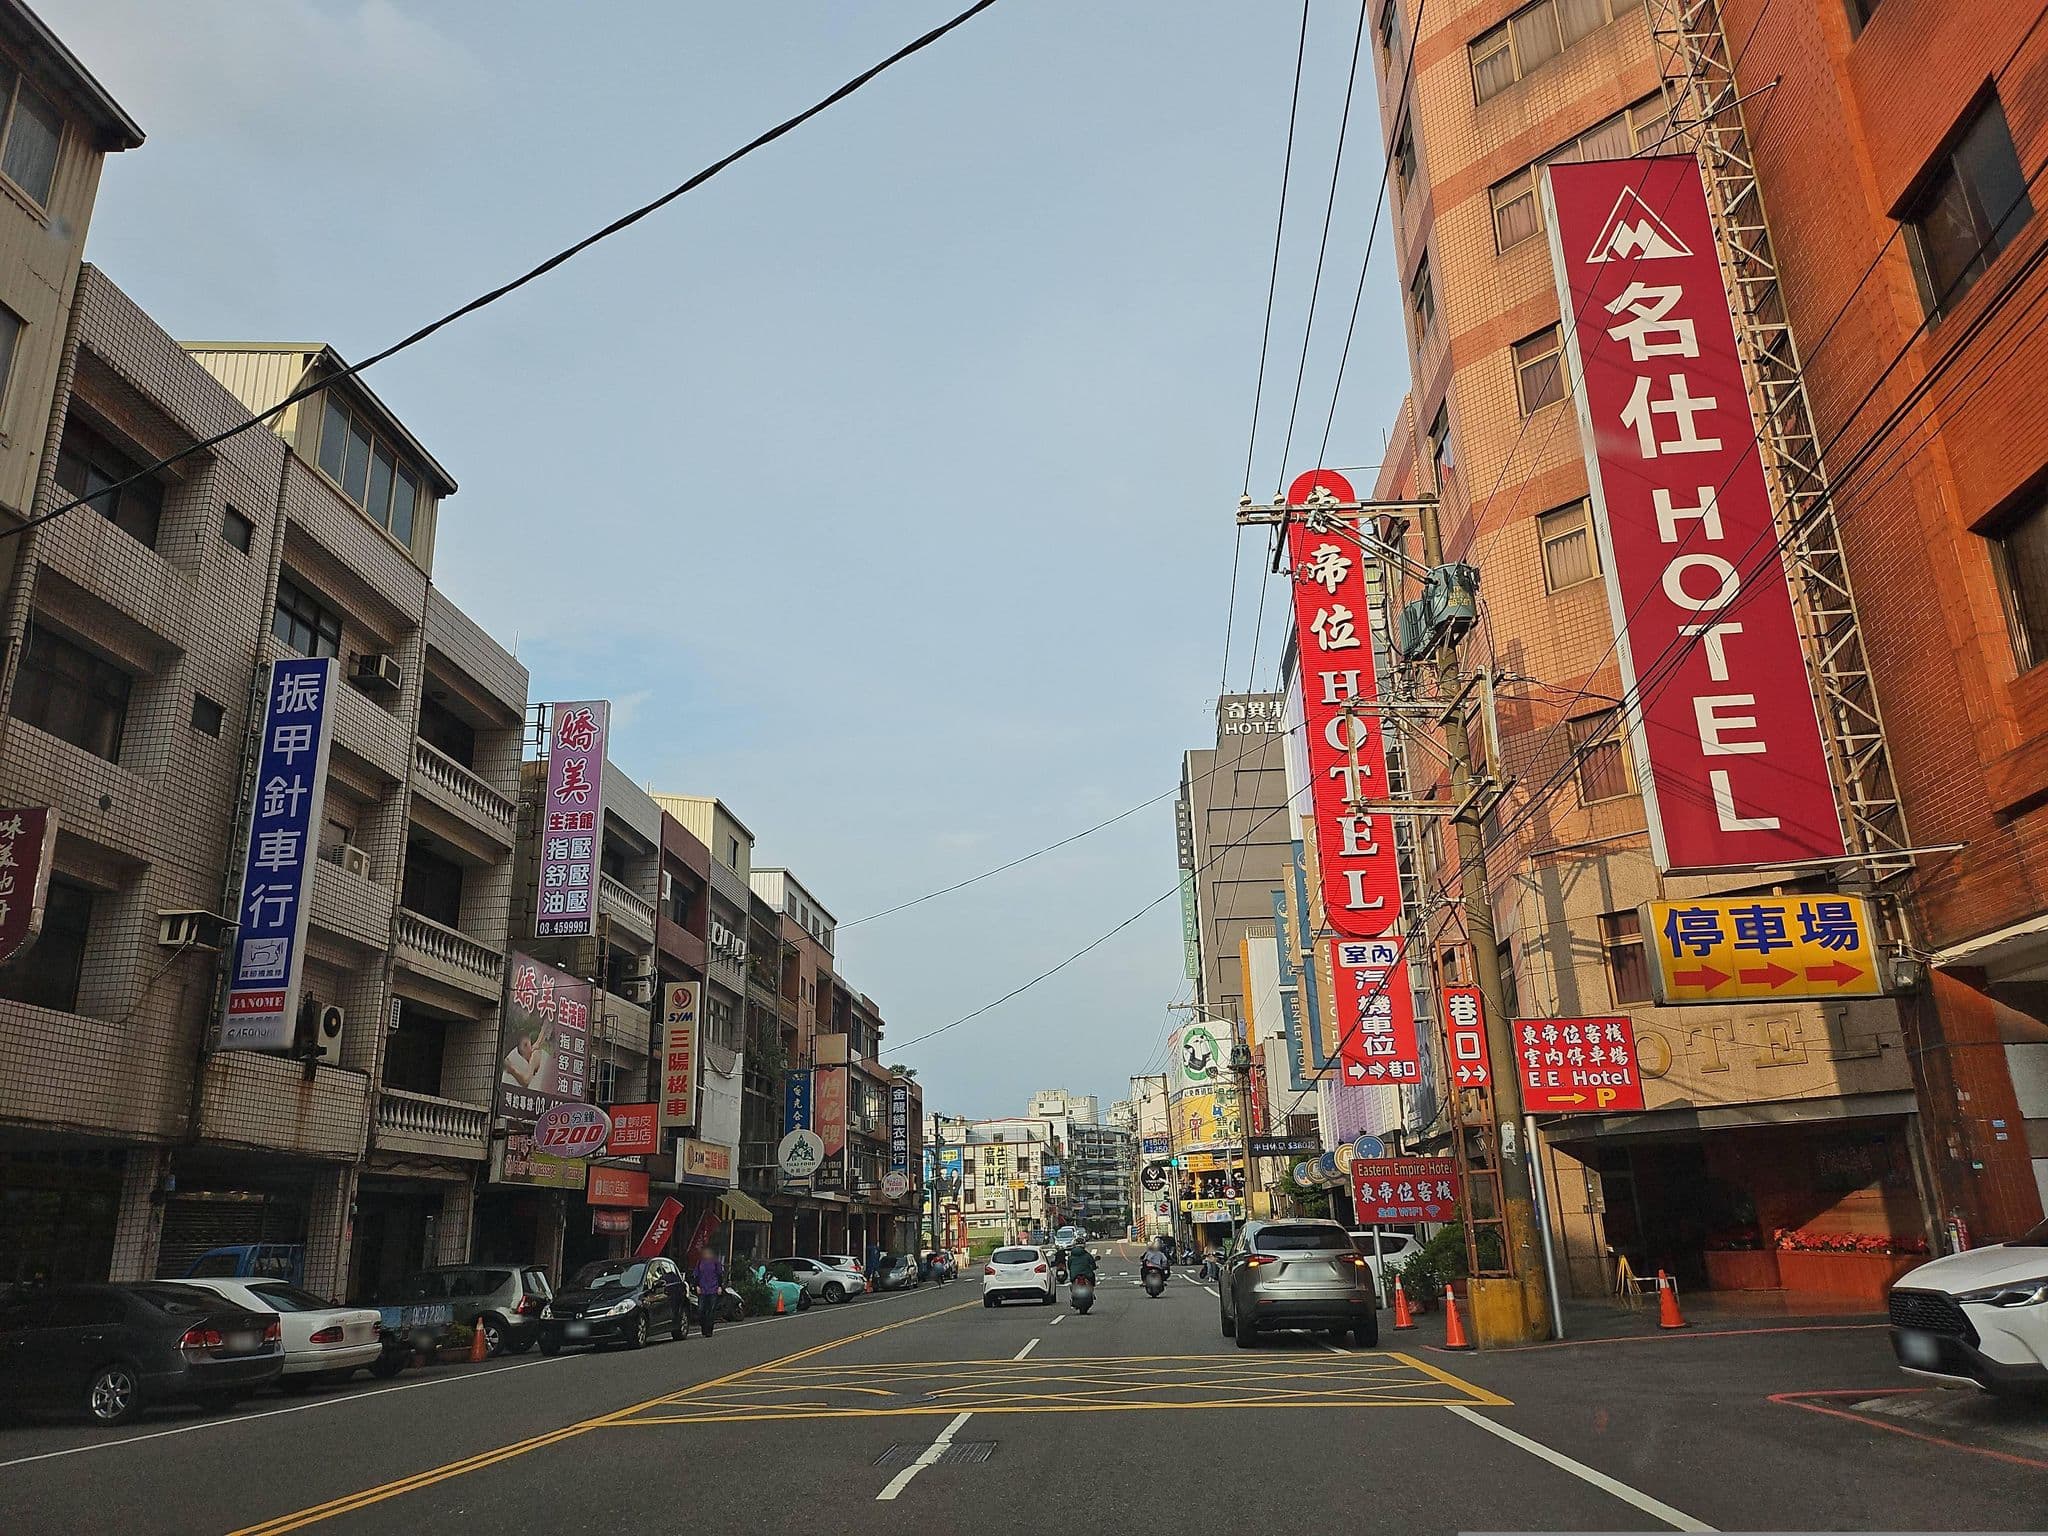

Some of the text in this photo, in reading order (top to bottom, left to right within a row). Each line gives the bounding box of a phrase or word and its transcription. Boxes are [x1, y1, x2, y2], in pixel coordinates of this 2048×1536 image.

[1605, 282, 1723, 460] 名仕
[1650, 485, 1781, 832] HOTEL
[1225, 721, 1285, 735] HOTEL
[554, 708, 600, 804] 嬌美
[249, 672, 320, 929] 振甲針車行
[1318, 672, 1384, 910] HOTEL
[548, 810, 595, 833] 生活館
[547, 836, 593, 861] 指壓
[545, 863, 590, 889] 舒壓
[542, 889, 589, 915] 油壓
[1663, 901, 1861, 959] 停車場
[1344, 945, 1394, 965] 室內
[231, 996, 284, 1009] JANOME
[514, 964, 557, 1023] 嬌美
[668, 1011, 694, 1023] SYM
[1290, 997, 1304, 1042] BENTLEY
[1449, 994, 1481, 1060] 巷口
[666, 1028, 690, 1117] 三陽機車
[1388, 1060, 1417, 1078] 巷口
[1528, 1067, 1632, 1087] E.E. Hotel
[1596, 1087, 1617, 1108] P
[547, 1110, 596, 1126] 90分鐘
[892, 1088, 906, 1165] 金龍縫衣機行
[543, 1124, 604, 1147] 1200
[614, 1128, 652, 1142] 店到店
[1358, 1163, 1391, 1177] Eastern
[1393, 1162, 1426, 1178] Empire
